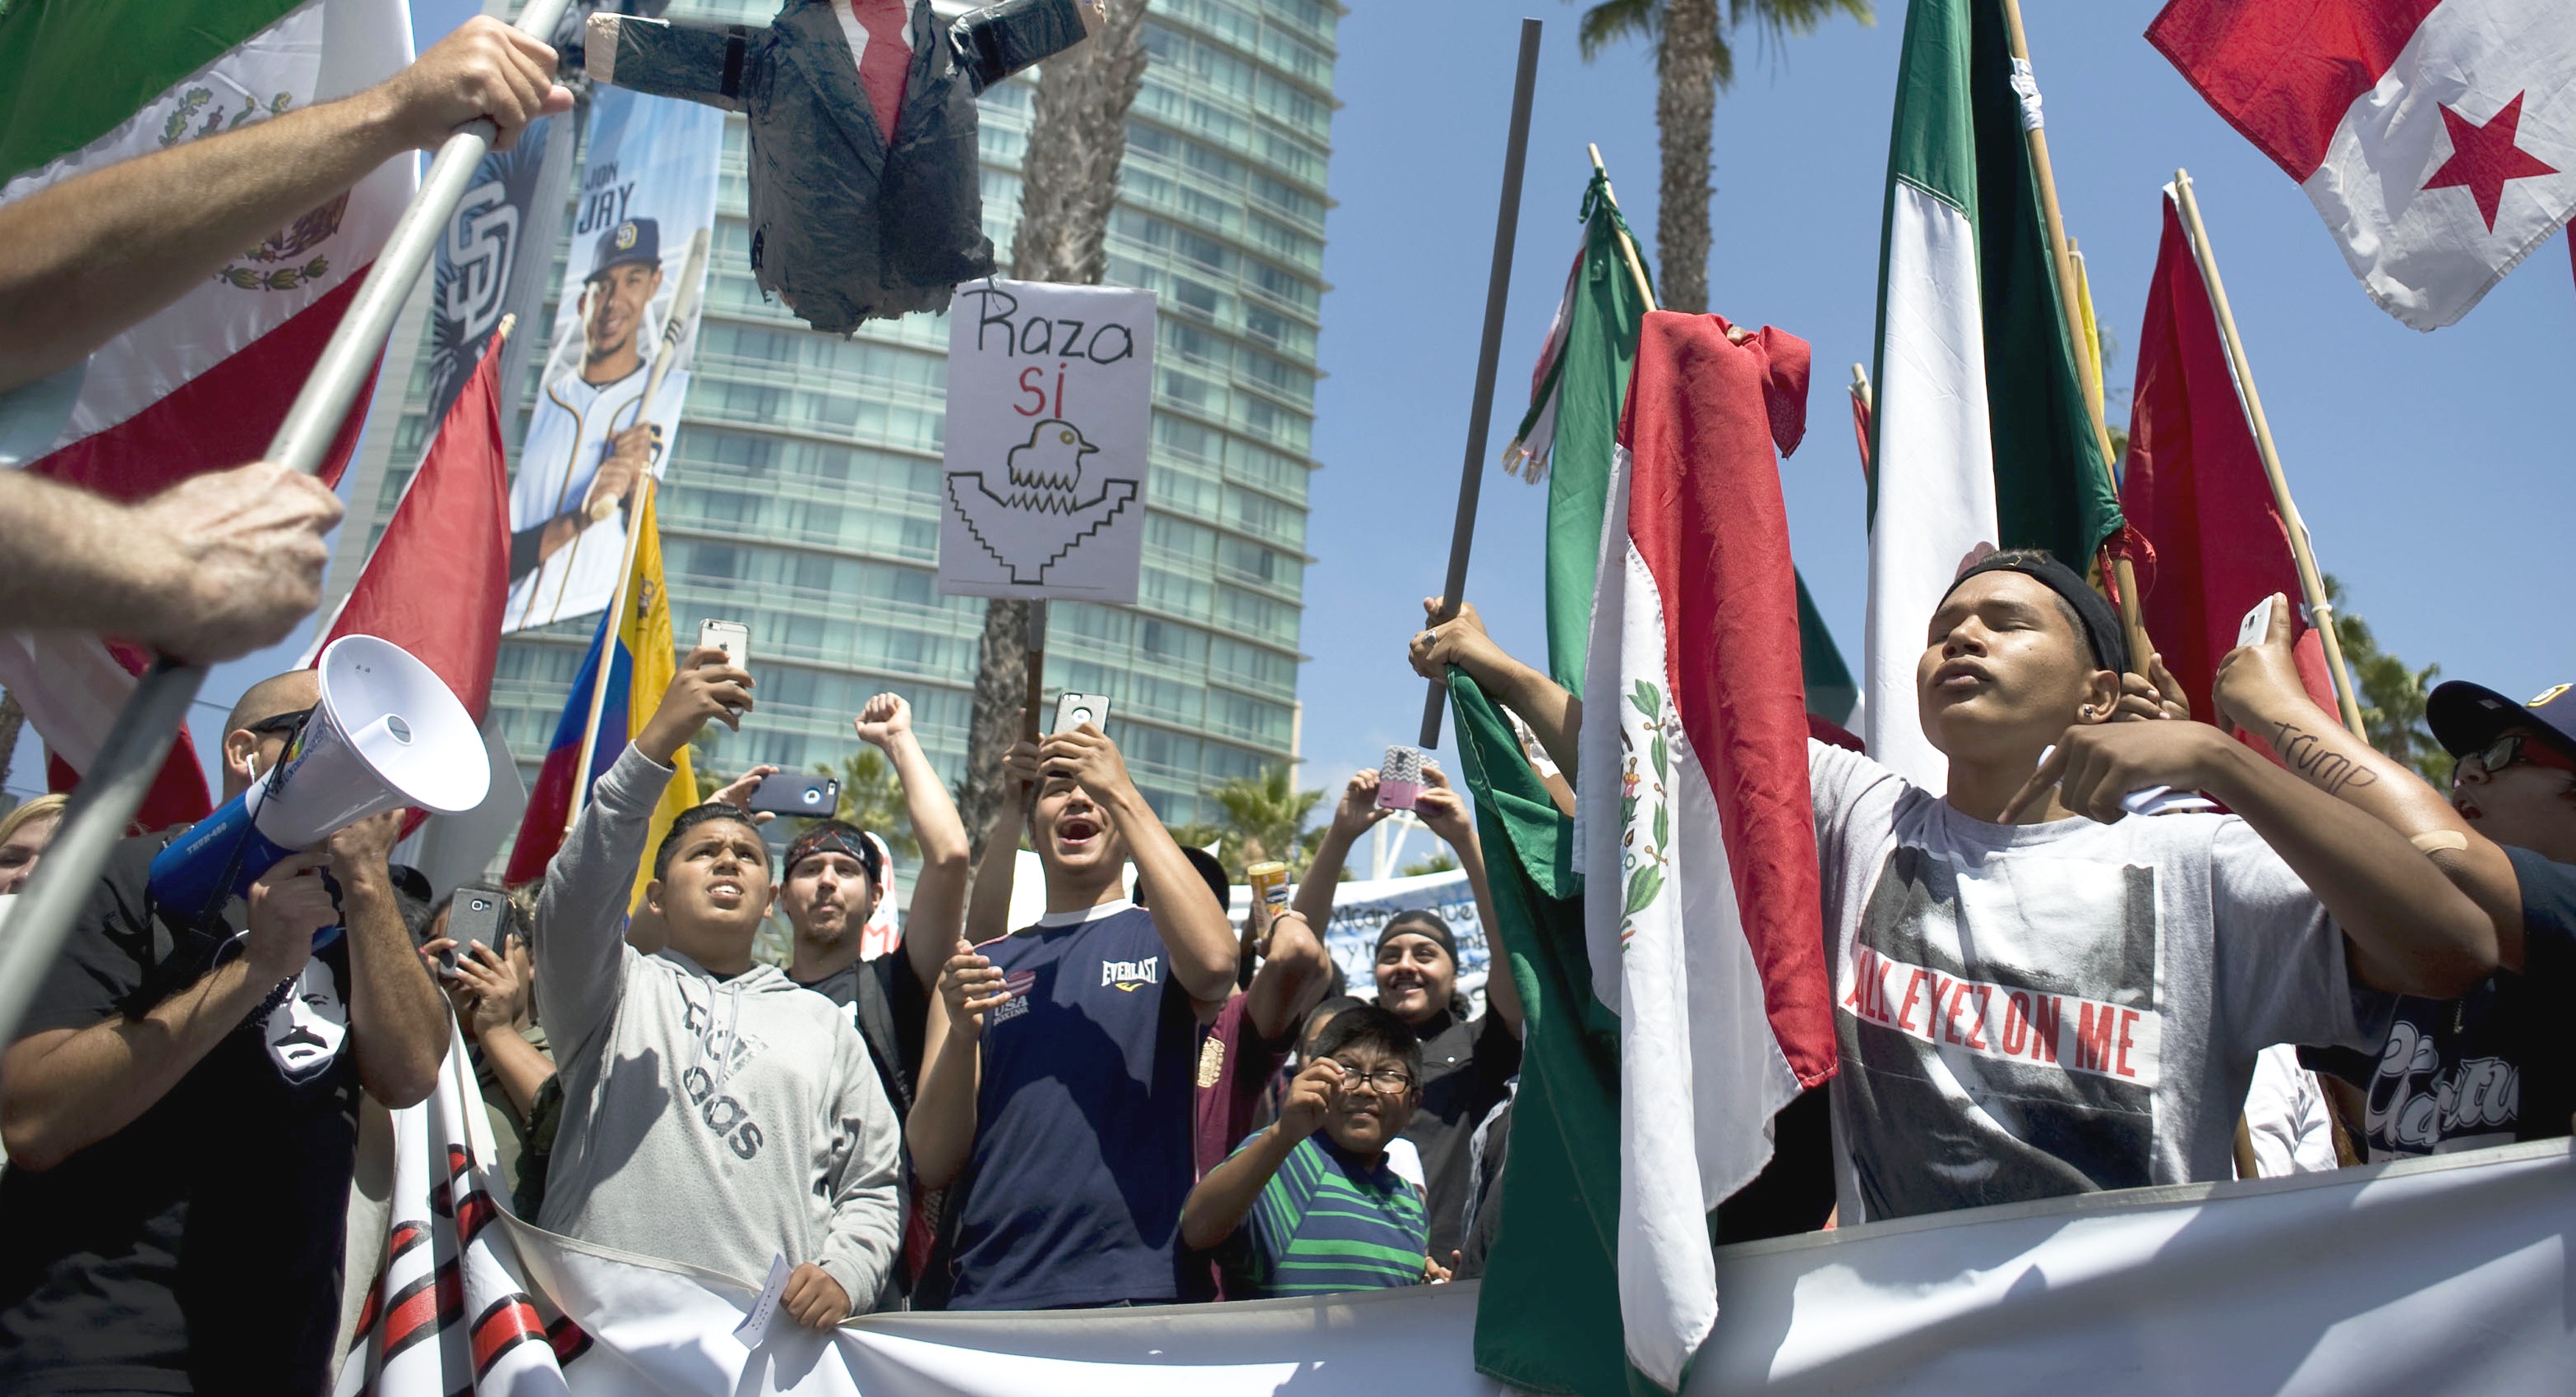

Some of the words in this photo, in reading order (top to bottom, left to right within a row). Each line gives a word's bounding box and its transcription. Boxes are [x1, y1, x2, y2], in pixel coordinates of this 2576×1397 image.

[584, 161, 619, 191] JON
[577, 180, 635, 234] JAY
[961, 288, 1133, 365] Raza
[1101, 956, 1158, 986] EVERLAST
[995, 994, 1029, 1017] USA
[1844, 949, 1892, 1024] ALL
[1897, 968, 1992, 1050] EYEZ
[2001, 990, 2061, 1063] ON
[2075, 1001, 2140, 1077] ME
